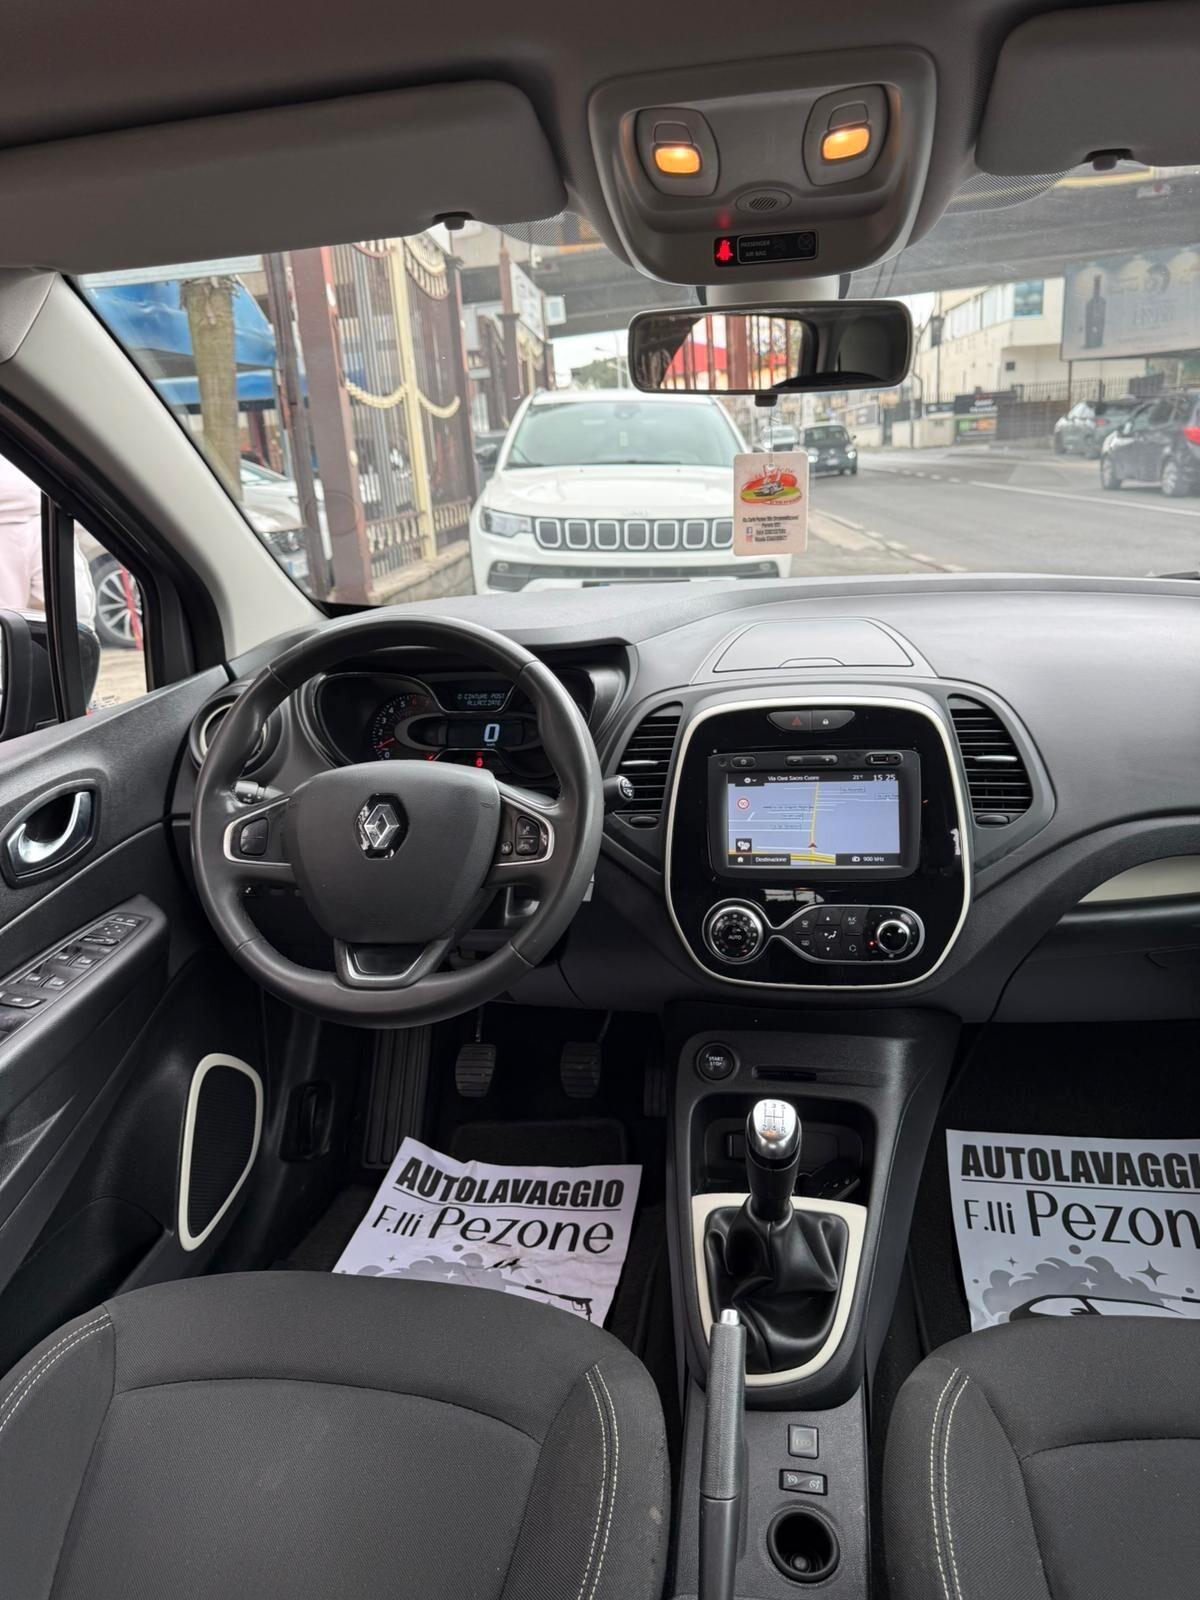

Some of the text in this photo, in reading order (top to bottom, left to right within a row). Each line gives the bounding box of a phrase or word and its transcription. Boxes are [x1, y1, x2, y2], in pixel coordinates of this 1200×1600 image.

[484, 723, 500, 742] 0
[395, 1156, 625, 1208] AUTOLAVAGGIO
[371, 1204, 614, 1254] F.lli Pezone
[963, 1199, 1016, 1235] F.lli
